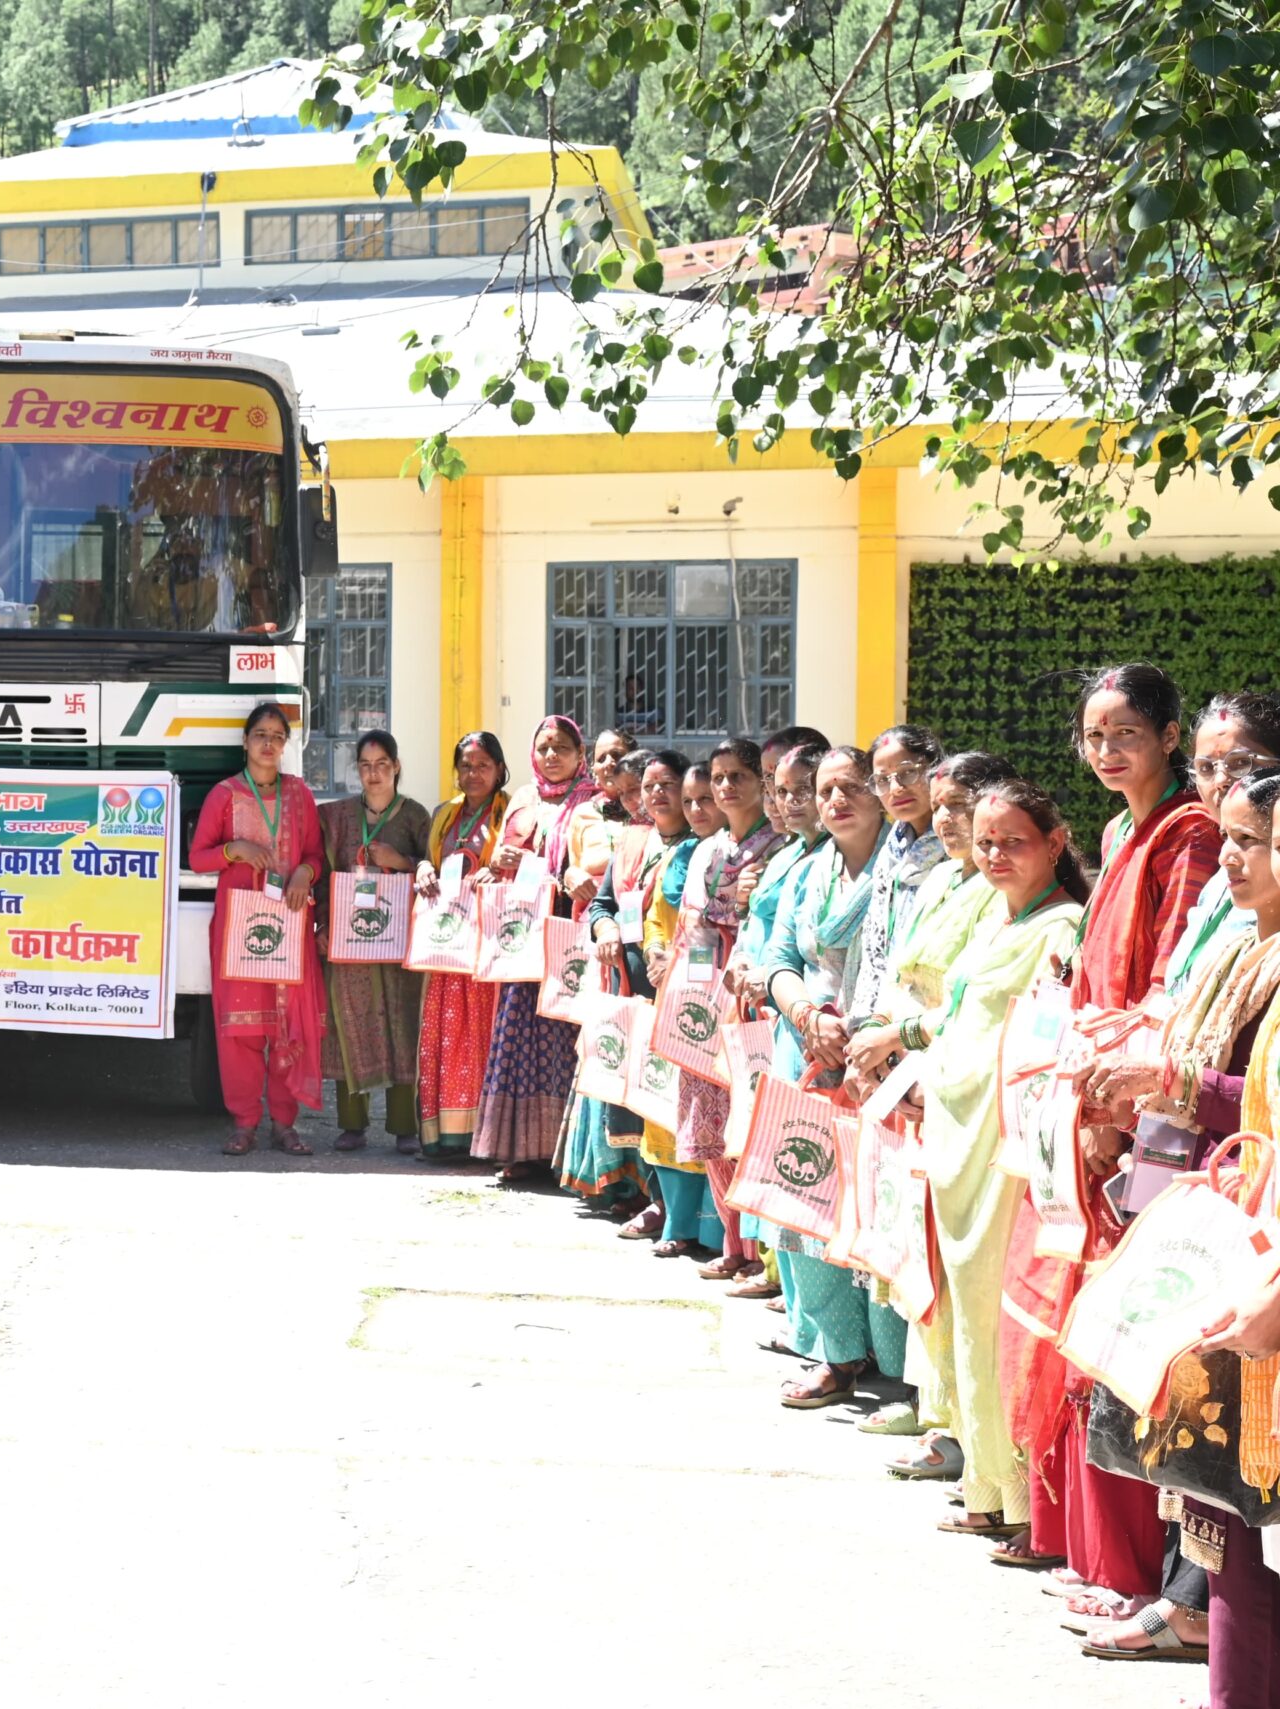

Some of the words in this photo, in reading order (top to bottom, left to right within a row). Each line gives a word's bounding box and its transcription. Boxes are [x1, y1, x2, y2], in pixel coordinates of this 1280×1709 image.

[150, 349, 169, 358] जय
[172, 350, 204, 361] जमुना
[1, 388, 240, 433] विश्वनाथ
[236, 652, 276, 671] लाभ
[6, 819, 90, 834] उत्तराखण्ड
[71, 841, 160, 879] योजना
[8, 923, 140, 963] कार्यक्रम
[4, 980, 44, 995] इंडिया
[48, 983, 93, 997] प्राइवेट
[97, 984, 151, 1000] लिमिटेड
[5, 1000, 41, 1011] Floor,
[108, 1004, 145, 1015] 70001
